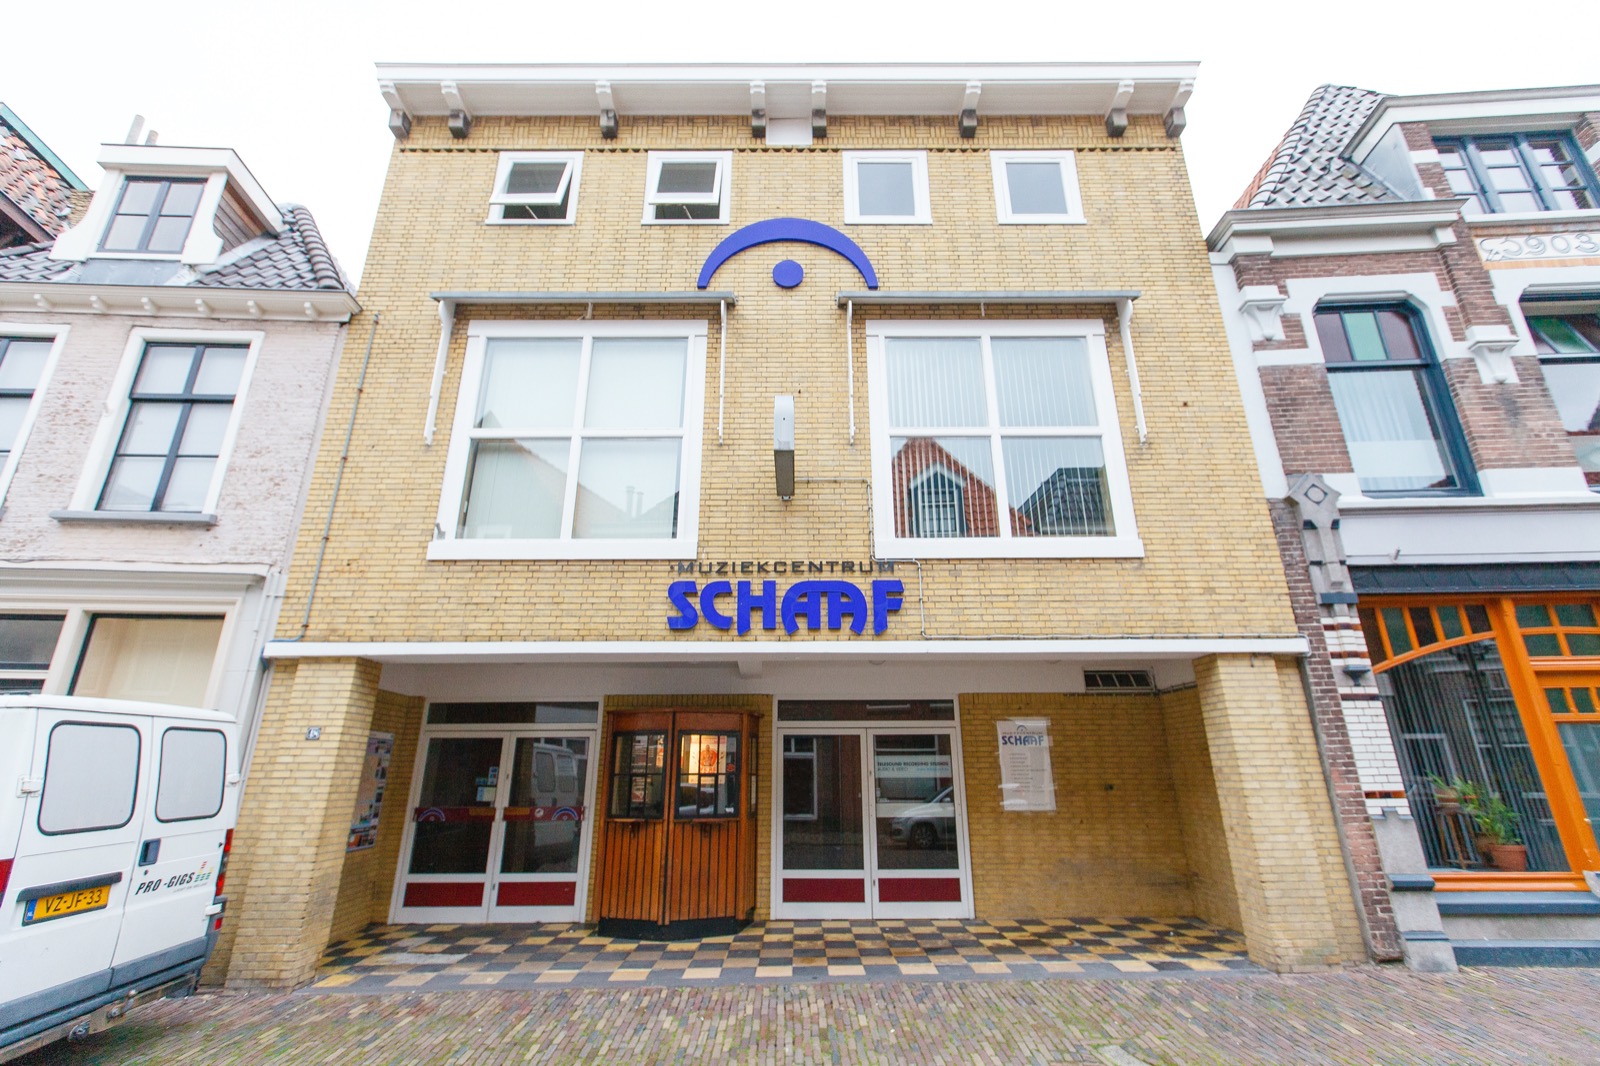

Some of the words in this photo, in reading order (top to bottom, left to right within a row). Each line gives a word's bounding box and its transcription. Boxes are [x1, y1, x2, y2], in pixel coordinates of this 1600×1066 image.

[677, 560, 895, 575] MUZIEKCENTRUM
[667, 580, 905, 636] SCHAAF
[1001, 735, 1044, 746] SCHAAF
[45, 889, 103, 913] VZ-JF-33
